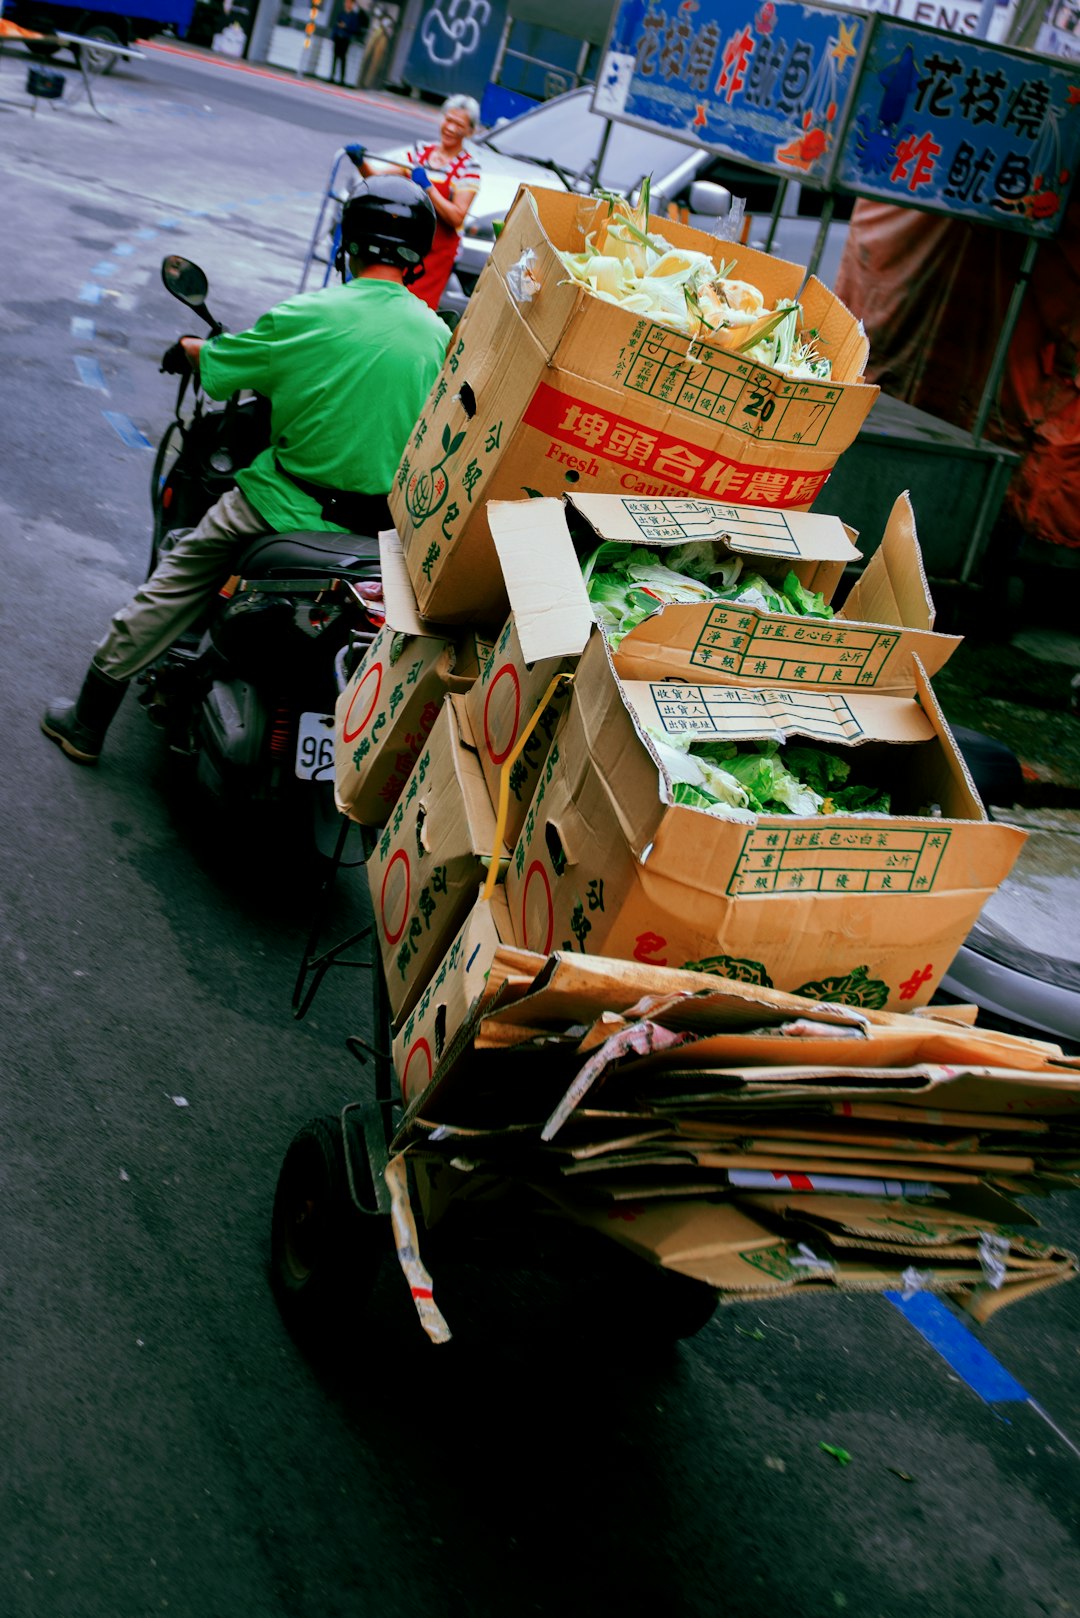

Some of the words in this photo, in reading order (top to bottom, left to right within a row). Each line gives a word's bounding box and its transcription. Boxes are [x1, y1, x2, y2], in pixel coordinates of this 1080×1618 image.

[914, 53, 1052, 140] 花枝燒
[682, 391, 695, 403] 特
[742, 392, 776, 422] 20
[545, 442, 600, 477] Fresh
[557, 404, 825, 502] 埤頭合作農場
[754, 659, 768, 675] 特
[793, 665, 807, 679] 優
[831, 668, 843, 682] 良
